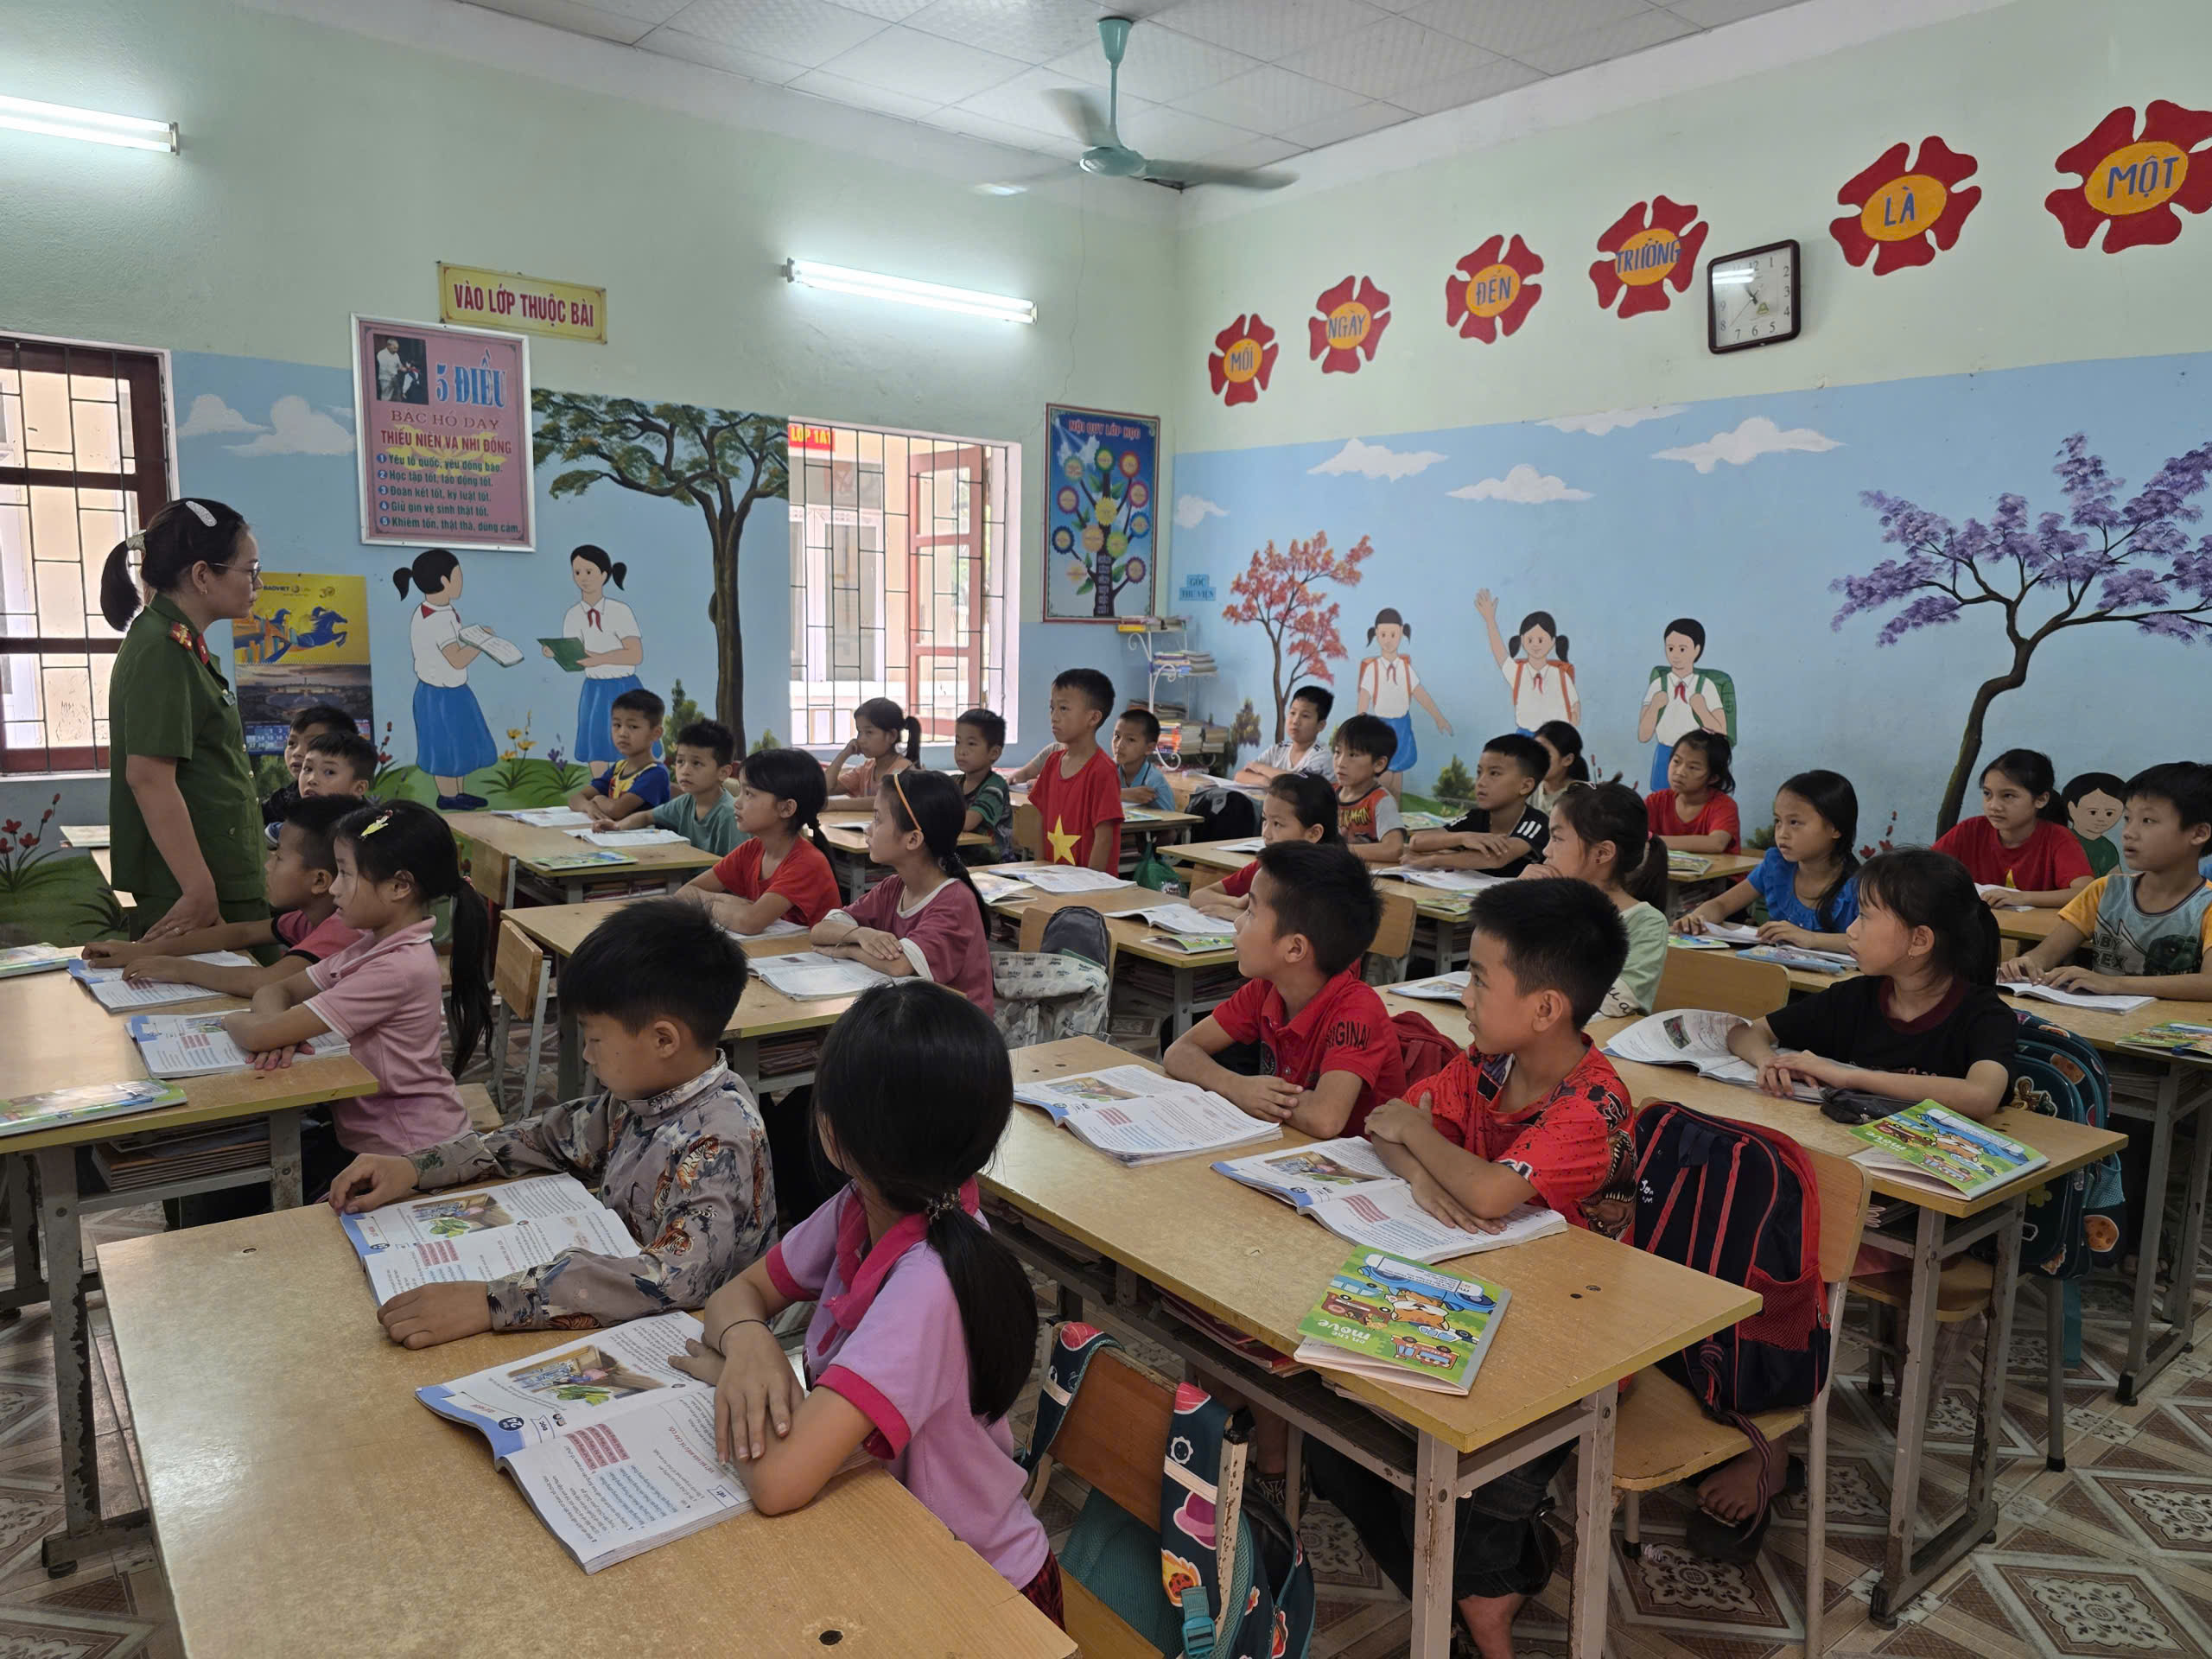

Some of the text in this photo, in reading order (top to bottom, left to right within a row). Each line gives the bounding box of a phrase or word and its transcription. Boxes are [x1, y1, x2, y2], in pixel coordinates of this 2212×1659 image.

[1328, 309, 1366, 339] NGÀY
[1476, 269, 1511, 306] ĐẾN
[1615, 238, 1682, 274] TRƯỜNG
[1884, 186, 1915, 227] LÀ
[2107, 155, 2179, 200] MỘT
[1770, 257, 1773, 268] 1
[1783, 266, 1789, 276] 2
[1783, 286, 1789, 297] 3
[454, 280, 594, 327] VÀO LỚP THUỘC BÀI
[1783, 306, 1790, 316] 4
[1720, 321, 1726, 331] 8
[1751, 325, 1758, 336] 6
[1770, 321, 1776, 334] 5
[1735, 329, 1741, 340] 7
[436, 349, 506, 408] 5 ĐIỀU
[391, 408, 427, 423] BÁC
[1318, 1319, 1371, 1340] move
[506, 1418, 522, 1427] 24
